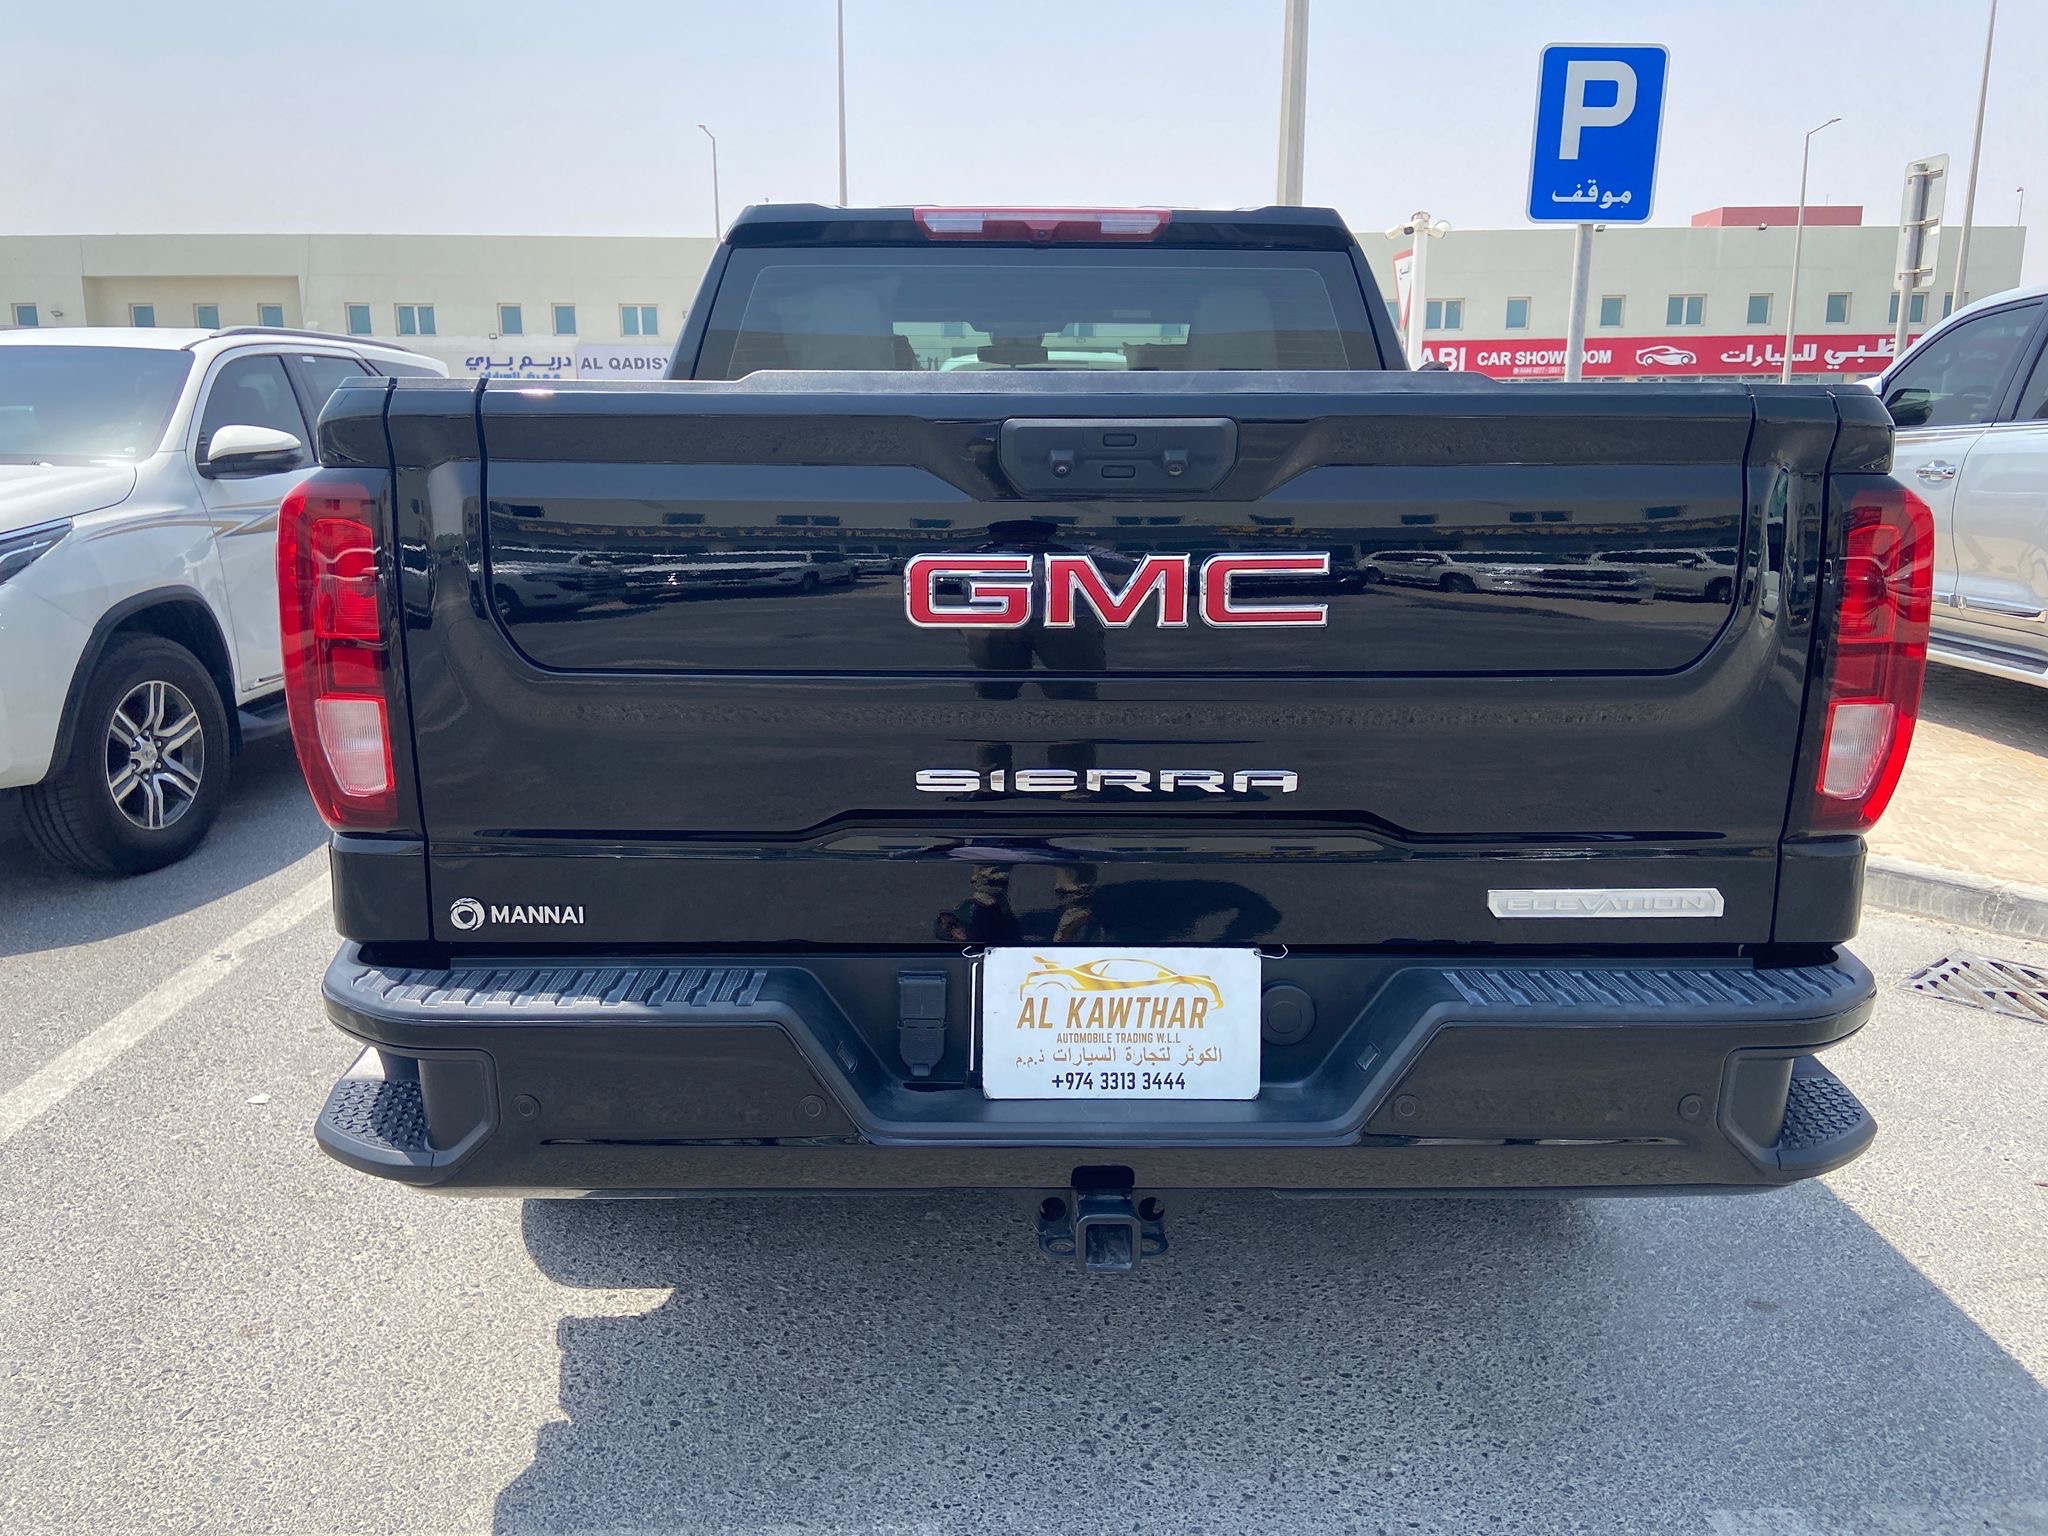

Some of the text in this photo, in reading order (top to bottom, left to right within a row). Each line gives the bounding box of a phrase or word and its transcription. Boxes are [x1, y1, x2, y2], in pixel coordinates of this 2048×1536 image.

[1559, 60, 1637, 160] P
[1551, 179, 1632, 209] موقف
[465, 355, 572, 370] دريم بري
[581, 357, 604, 370] AL
[1477, 350, 1612, 366] CAR SHOWOM
[1720, 343, 1817, 367] للسيارات
[904, 552, 1330, 629] GMC
[915, 768, 1299, 792] SIERRA
[490, 905, 585, 924] MANNAI
[1506, 894, 1710, 914] ELEVATION
[1016, 996, 1209, 1029] AL KAWTHAR
[1056, 1032, 1112, 1044] AUTOMOBILE
[1116, 1032, 1153, 1044] TRADING
[1052, 1046, 1117, 1067] السيارات
[1125, 1046, 1171, 1067] لتجارة
[1178, 1045, 1222, 1067] الكوثر
[1051, 1072, 1186, 1090] +974 3313 3444
